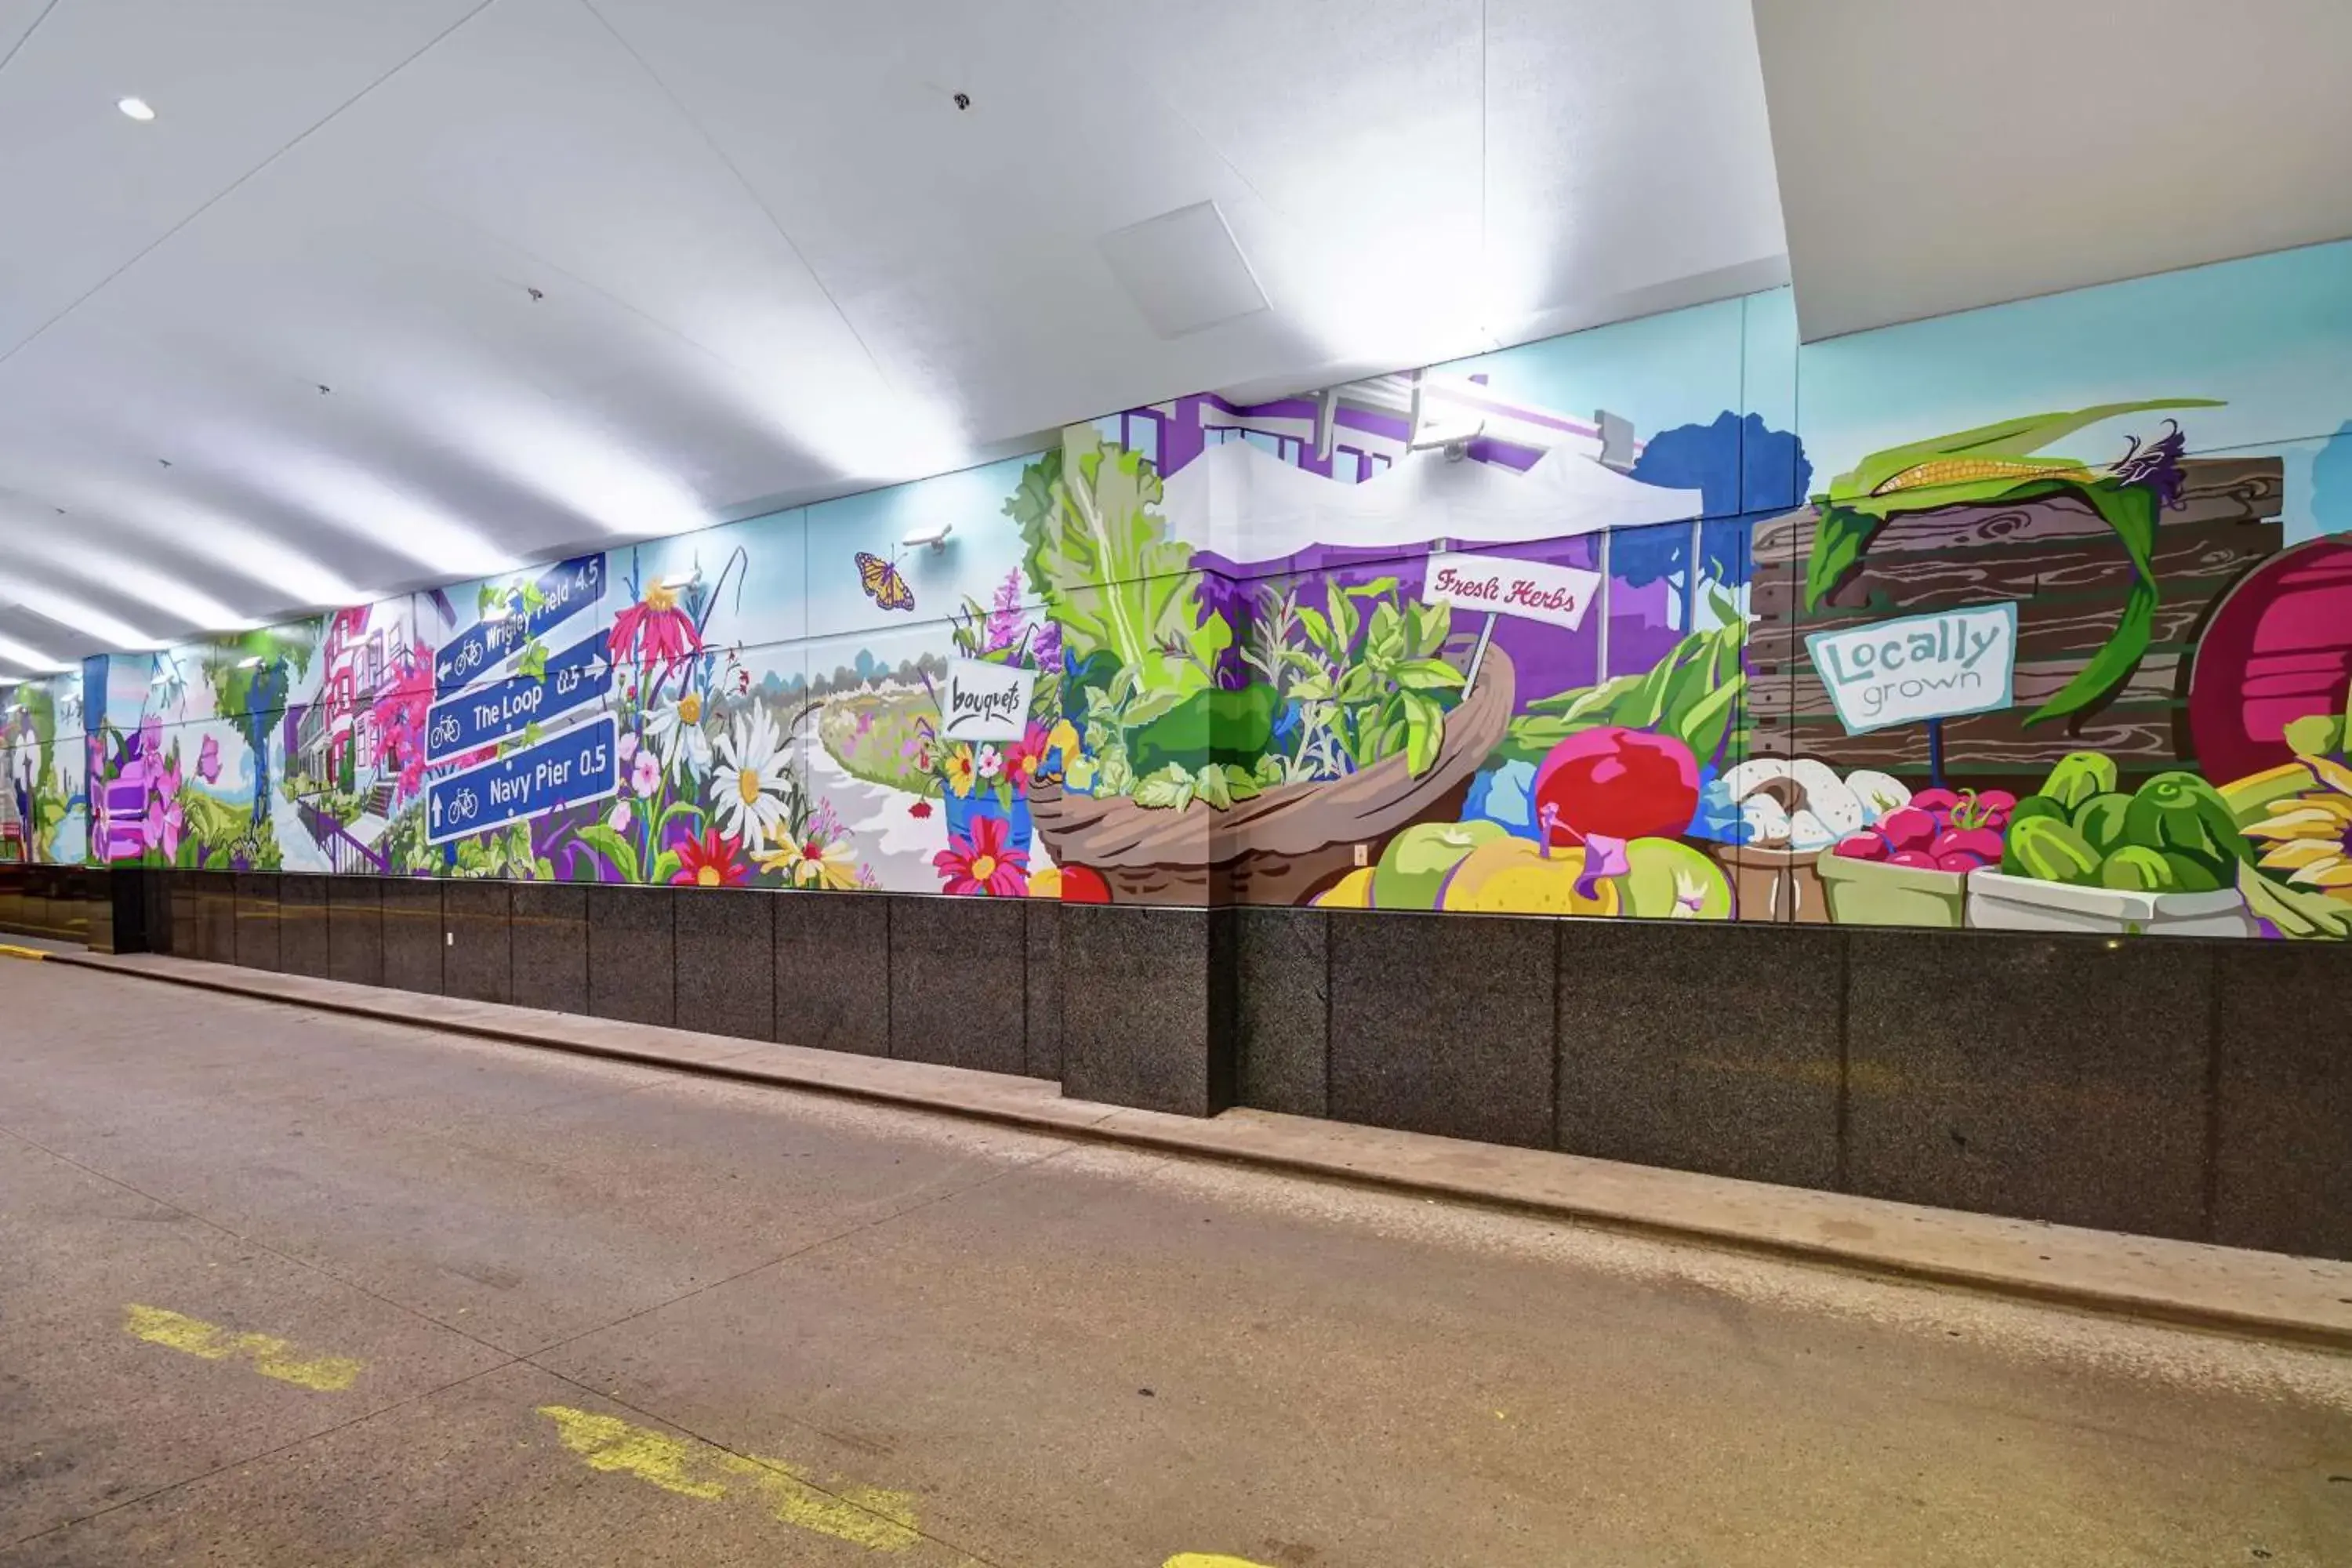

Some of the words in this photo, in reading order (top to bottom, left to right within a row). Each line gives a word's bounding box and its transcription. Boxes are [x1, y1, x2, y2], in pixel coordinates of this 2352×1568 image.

[575, 557, 599, 590] 4.5
[1435, 568, 1499, 601] Fresh
[1504, 579, 1575, 612] Herbs
[1825, 619, 1999, 686] Locally
[474, 704, 500, 731] The
[503, 684, 543, 720] Loop
[557, 664, 580, 695] 0.5
[953, 674, 1020, 722] bouquets
[1861, 670, 1981, 717] grown
[490, 772, 532, 806] Navy
[535, 758, 572, 792] Pier
[579, 743, 606, 776] 0.5
